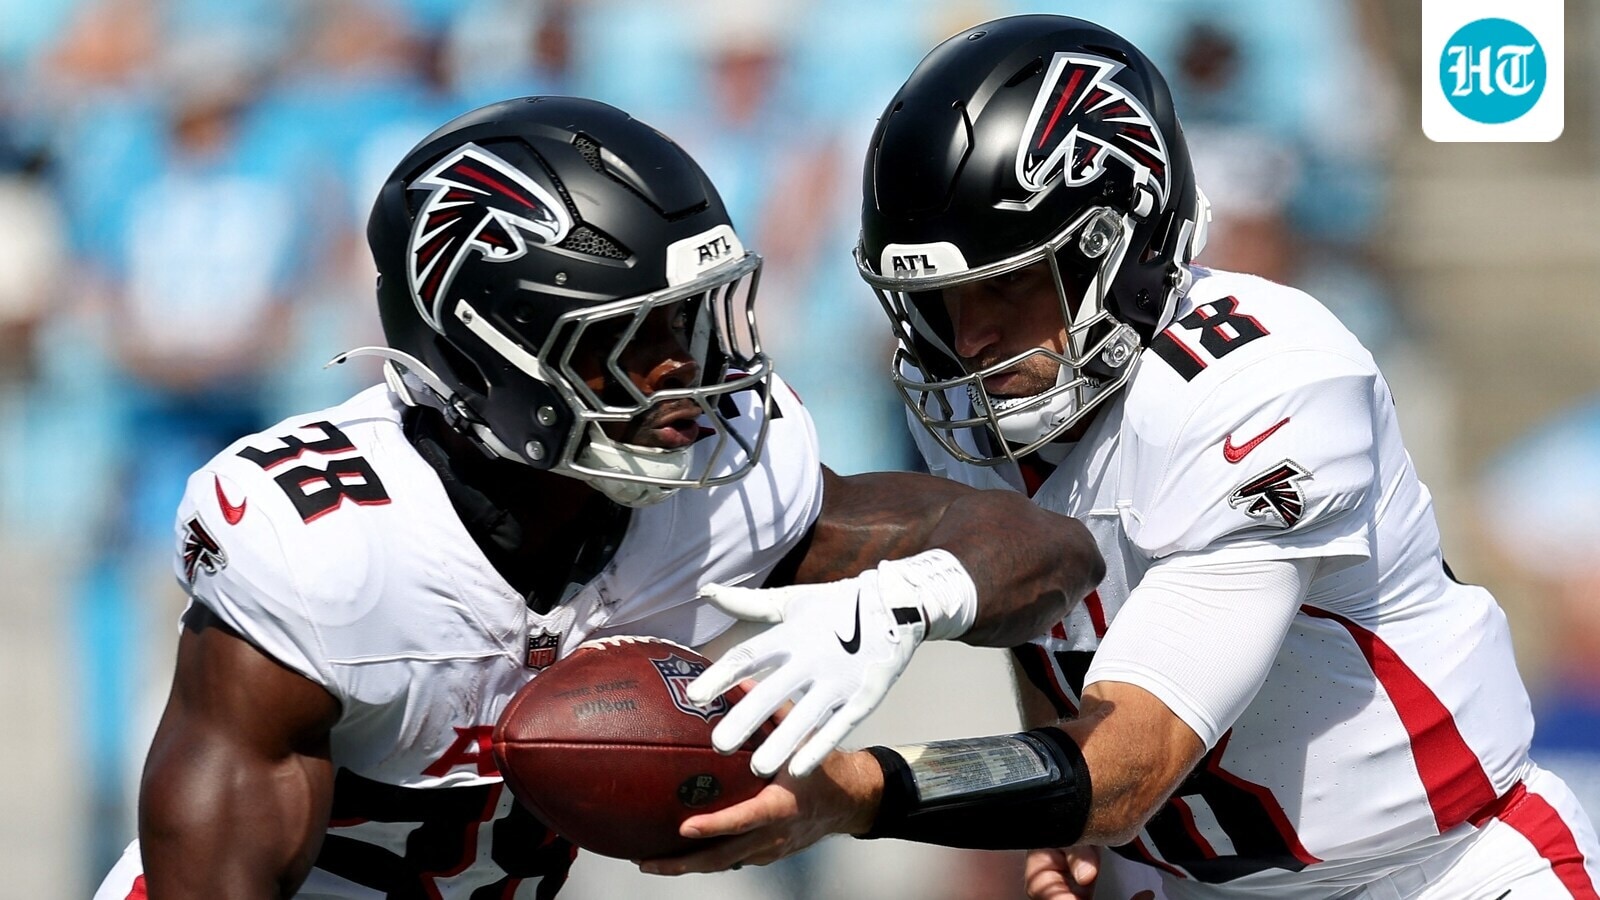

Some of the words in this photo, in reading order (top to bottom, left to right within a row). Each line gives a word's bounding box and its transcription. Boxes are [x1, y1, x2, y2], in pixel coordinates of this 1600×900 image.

[696, 235, 730, 264] ATL
[892, 254, 936, 271] ATL
[1150, 295, 1271, 383] 18
[235, 420, 392, 525] 38
[573, 698, 637, 719] Wilson
